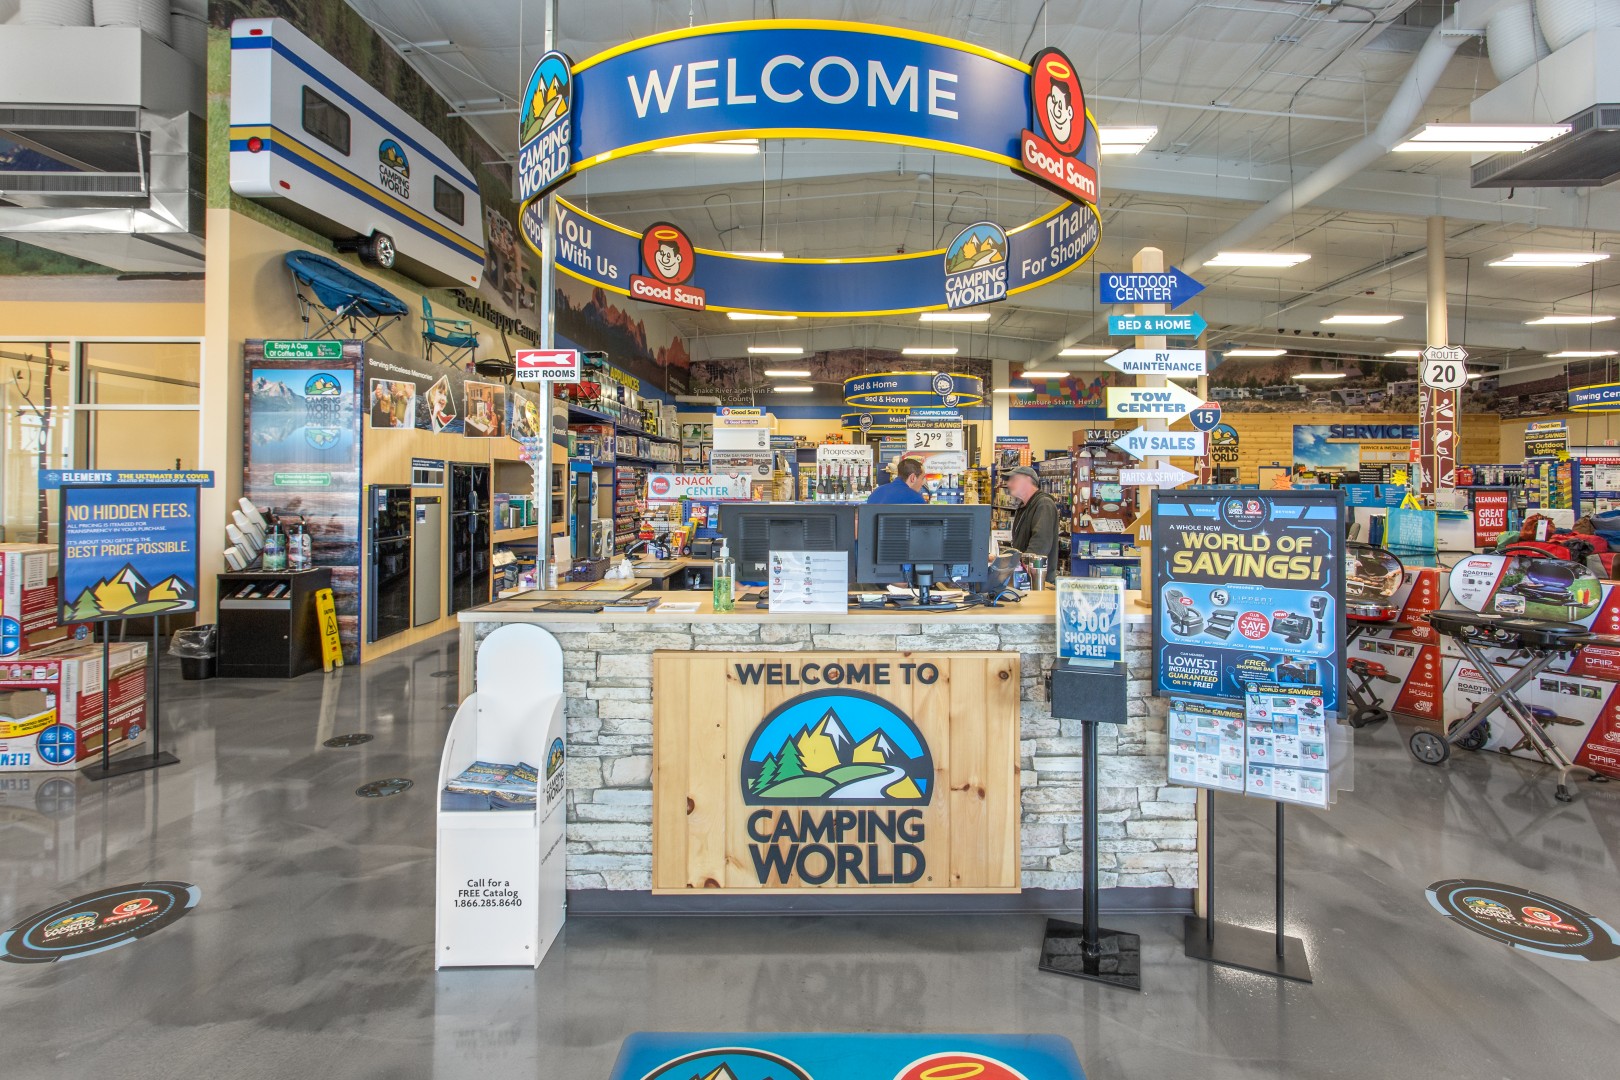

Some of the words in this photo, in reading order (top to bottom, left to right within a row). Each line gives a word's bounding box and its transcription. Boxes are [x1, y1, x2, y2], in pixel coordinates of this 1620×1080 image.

[627, 54, 959, 120] WELCOME
[519, 119, 570, 174] CAMPING
[519, 146, 569, 200] WORLD
[1025, 139, 1064, 179] Good
[1066, 162, 1095, 196] Sam
[379, 164, 410, 190] CAMPING
[379, 174, 410, 200] WORLD
[556, 209, 591, 250] You
[1022, 257, 1047, 279] For
[1050, 220, 1097, 268] Shopping
[560, 240, 592, 271] With
[597, 255, 618, 279] Us
[945, 265, 1006, 292] CAMPING
[1109, 275, 1177, 288] OUTDOOR
[633, 280, 671, 300] Good
[674, 288, 704, 306] Sam
[945, 281, 1006, 308] WORLD
[1115, 288, 1172, 300] CENTER
[1117, 320, 1141, 330] BED
[1144, 320, 1152, 330] &
[1155, 320, 1191, 330] HOME
[1155, 353, 1170, 361] RV
[1430, 351, 1459, 359] ROUTE
[369, 358, 389, 371] Serving
[389, 363, 411, 376] Priceless
[411, 368, 433, 381] Memories
[1123, 361, 1202, 371] MAINTENANCE
[517, 370, 539, 378] REST
[542, 370, 575, 378] ROOMS
[1432, 365, 1456, 383] 20
[853, 383, 865, 391] Bed
[872, 381, 898, 389] Home
[1013, 398, 1052, 406] Adventure
[1130, 392, 1172, 402] TOW
[1575, 393, 1601, 401] Towing
[305, 403, 340, 412] WORLD
[1117, 403, 1186, 413] CENTER
[1197, 411, 1214, 424] 15
[1088, 430, 1101, 438] RV
[1330, 424, 1413, 439] SERVICE
[1129, 437, 1148, 449] RV
[1150, 437, 1196, 450] SALES
[823, 447, 866, 456] Progressive
[1211, 446, 1239, 454] AMPING
[1211, 454, 1239, 462] ORLD
[62, 472, 112, 482] ELEMENTS
[675, 476, 713, 485] SNACK
[1121, 472, 1146, 482] PARTS
[1146, 472, 1154, 481] &
[1155, 472, 1186, 481] SERVICE
[686, 487, 729, 496] CENTER
[67, 505, 89, 521] NO
[93, 503, 149, 520] HIDDEN
[152, 502, 191, 518] FEES.
[1478, 509, 1504, 517] GREAT
[1479, 518, 1503, 527] DEALS
[1181, 531, 1270, 552] WORLD
[1276, 536, 1312, 553] OF
[67, 545, 97, 559] BEST
[101, 544, 133, 557] PRICE
[137, 541, 190, 555] POSSIBLE.
[1172, 550, 1323, 581] SAVINGS!
[1241, 621, 1267, 632] SAVE
[1064, 632, 1117, 646] SHOPPING
[1244, 630, 1261, 638] BIG!
[1074, 644, 1107, 657] SPREE!
[1168, 656, 1218, 670] LOWEST
[1244, 659, 1267, 667] FREE
[1585, 657, 1613, 666] DRIP
[735, 663, 891, 685] WELCOME
[899, 663, 939, 685] TO
[1168, 665, 1200, 675] INSTALLED
[1200, 669, 1218, 677] PRICE
[1168, 672, 1219, 683] GUARANTEED
[1193, 681, 1213, 689] FREE!
[1288, 688, 1321, 696] SAVINGS!
[1212, 709, 1243, 718] SAVINGS!
[1589, 753, 1617, 763] DRIP
[546, 767, 564, 794] CAMPING
[546, 778, 565, 805] WORLD
[747, 809, 926, 844] CAMPING
[747, 843, 927, 885] WORLD
[467, 879, 485, 888] Call
[488, 879, 502, 887] for
[458, 889, 480, 898] FREE
[483, 888, 519, 899] Catalog
[454, 898, 522, 908] 1.866.285.8640
[67, 929, 84, 938] 50
[89, 916, 137, 932] YEARS
[1513, 920, 1562, 934] YEARS
